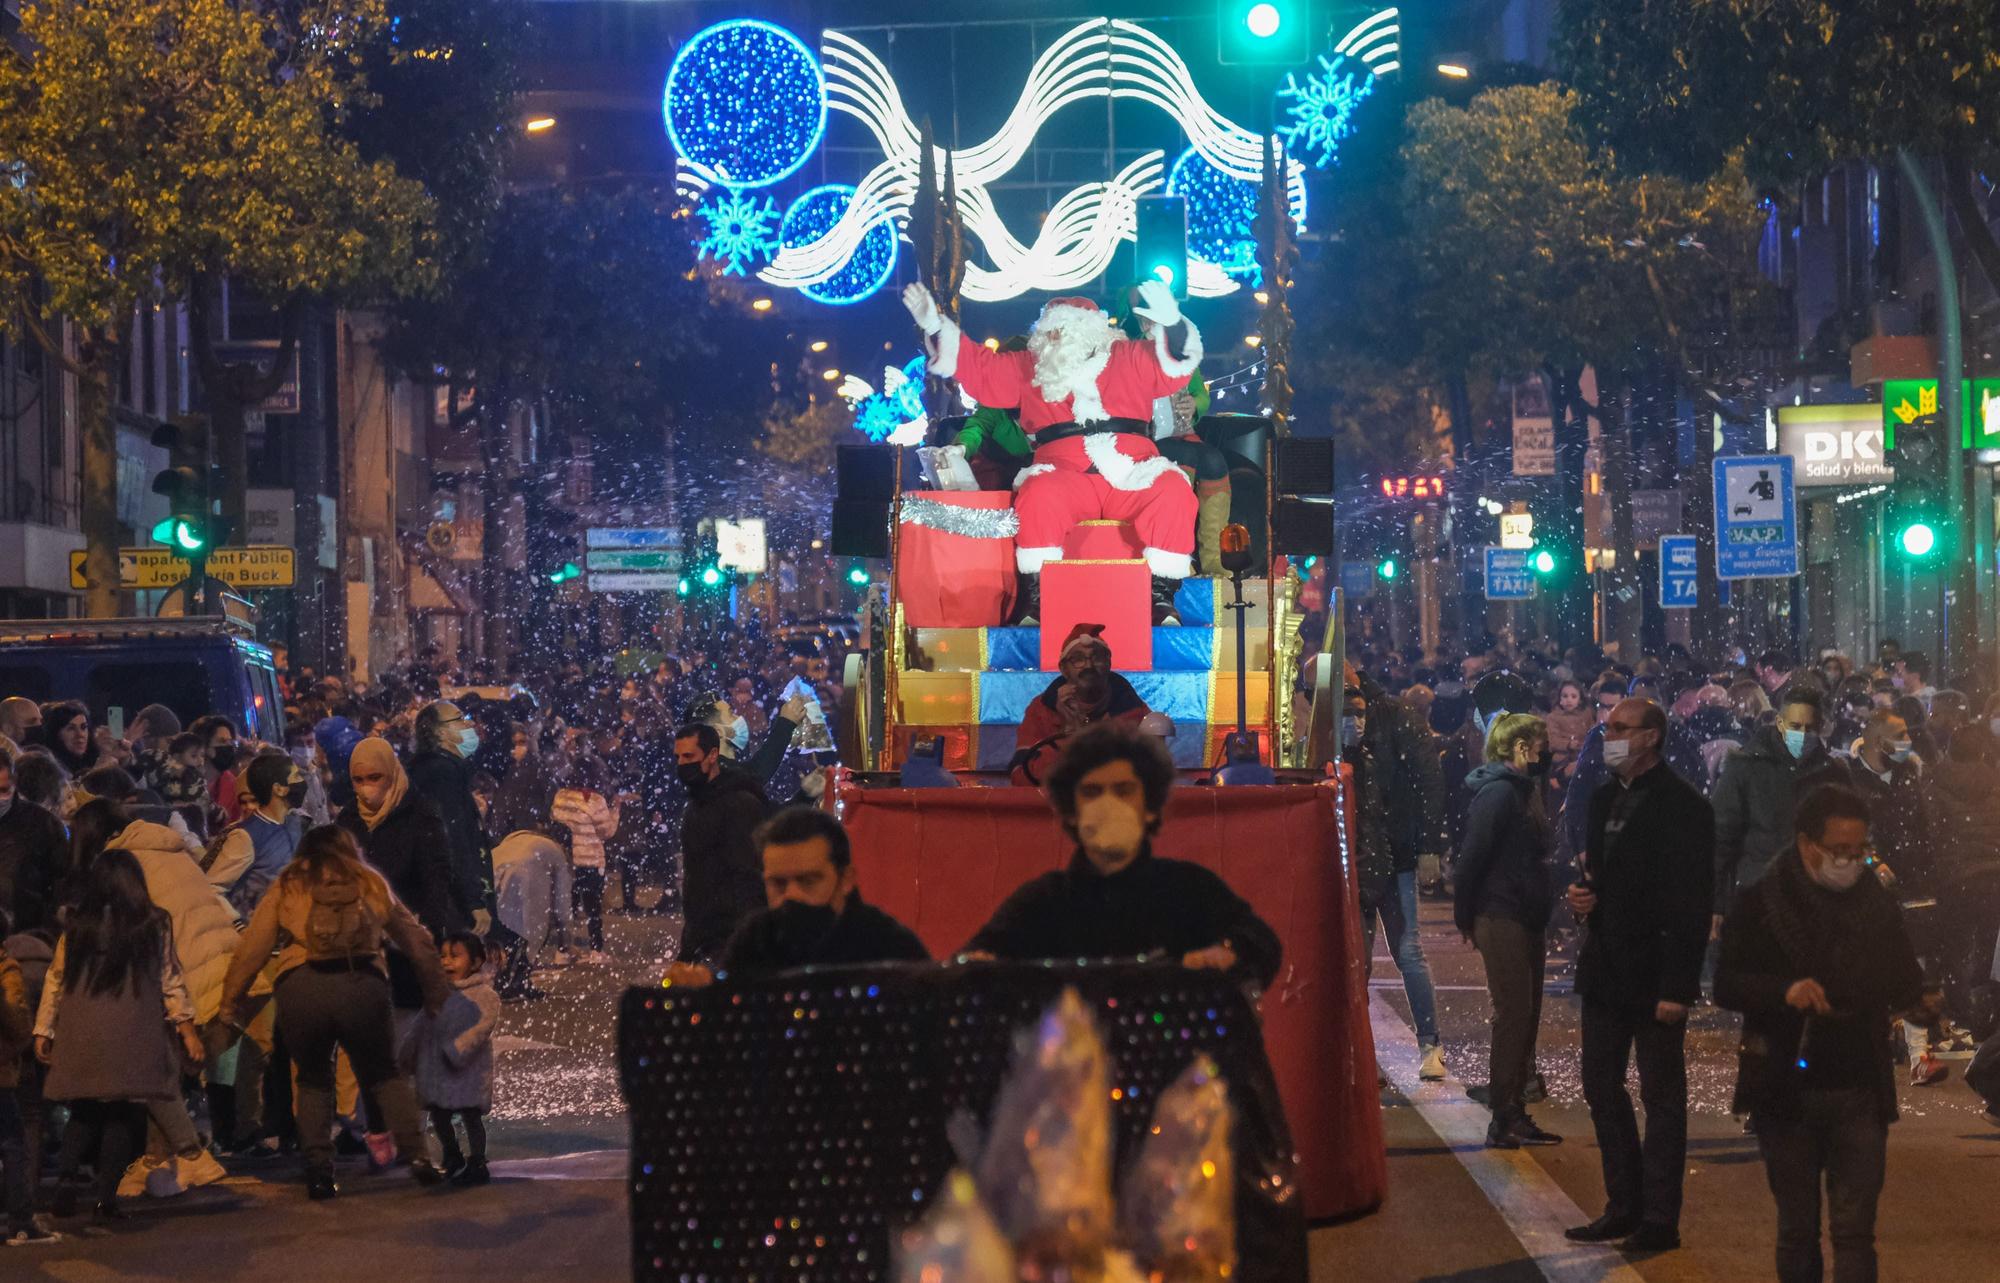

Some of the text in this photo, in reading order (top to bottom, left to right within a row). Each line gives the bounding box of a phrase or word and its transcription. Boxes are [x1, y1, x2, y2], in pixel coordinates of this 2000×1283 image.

[1806, 462, 1840, 477] Salud
[1843, 465, 1851, 478] y
[239, 569, 280, 581] Buck
[1494, 578, 1527, 591] TAXI
